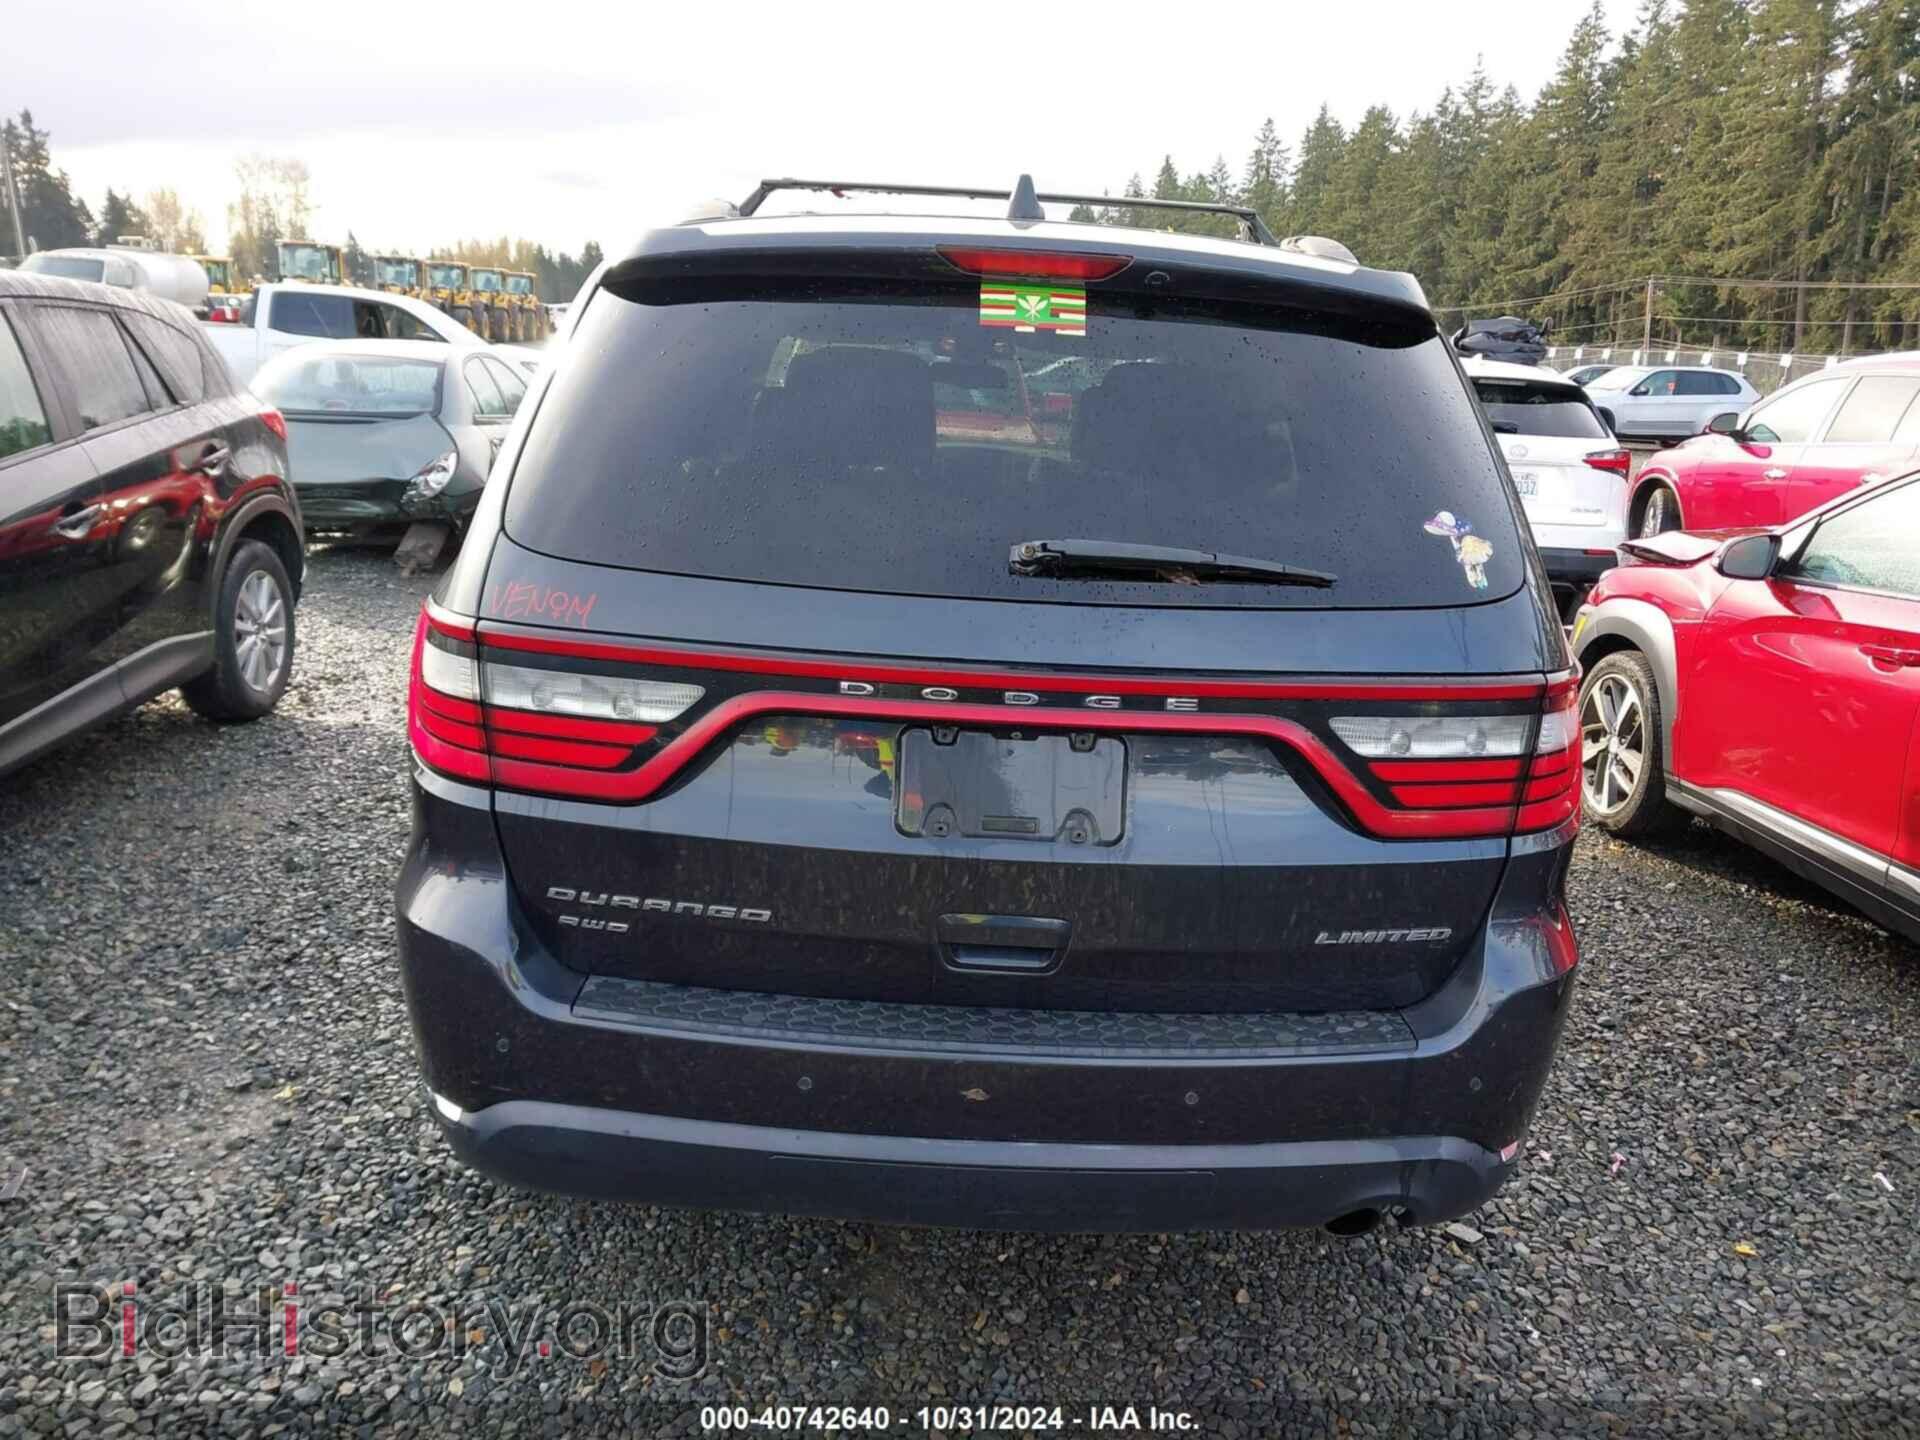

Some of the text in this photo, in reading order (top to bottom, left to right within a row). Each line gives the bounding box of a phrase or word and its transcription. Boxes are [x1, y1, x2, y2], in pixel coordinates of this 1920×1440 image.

[490, 583, 598, 628] VENOM
[839, 680, 1200, 711] DODGE
[546, 887, 772, 923] DURANGO
[558, 915, 629, 932] AWD
[1314, 928, 1452, 944] LIMITED
